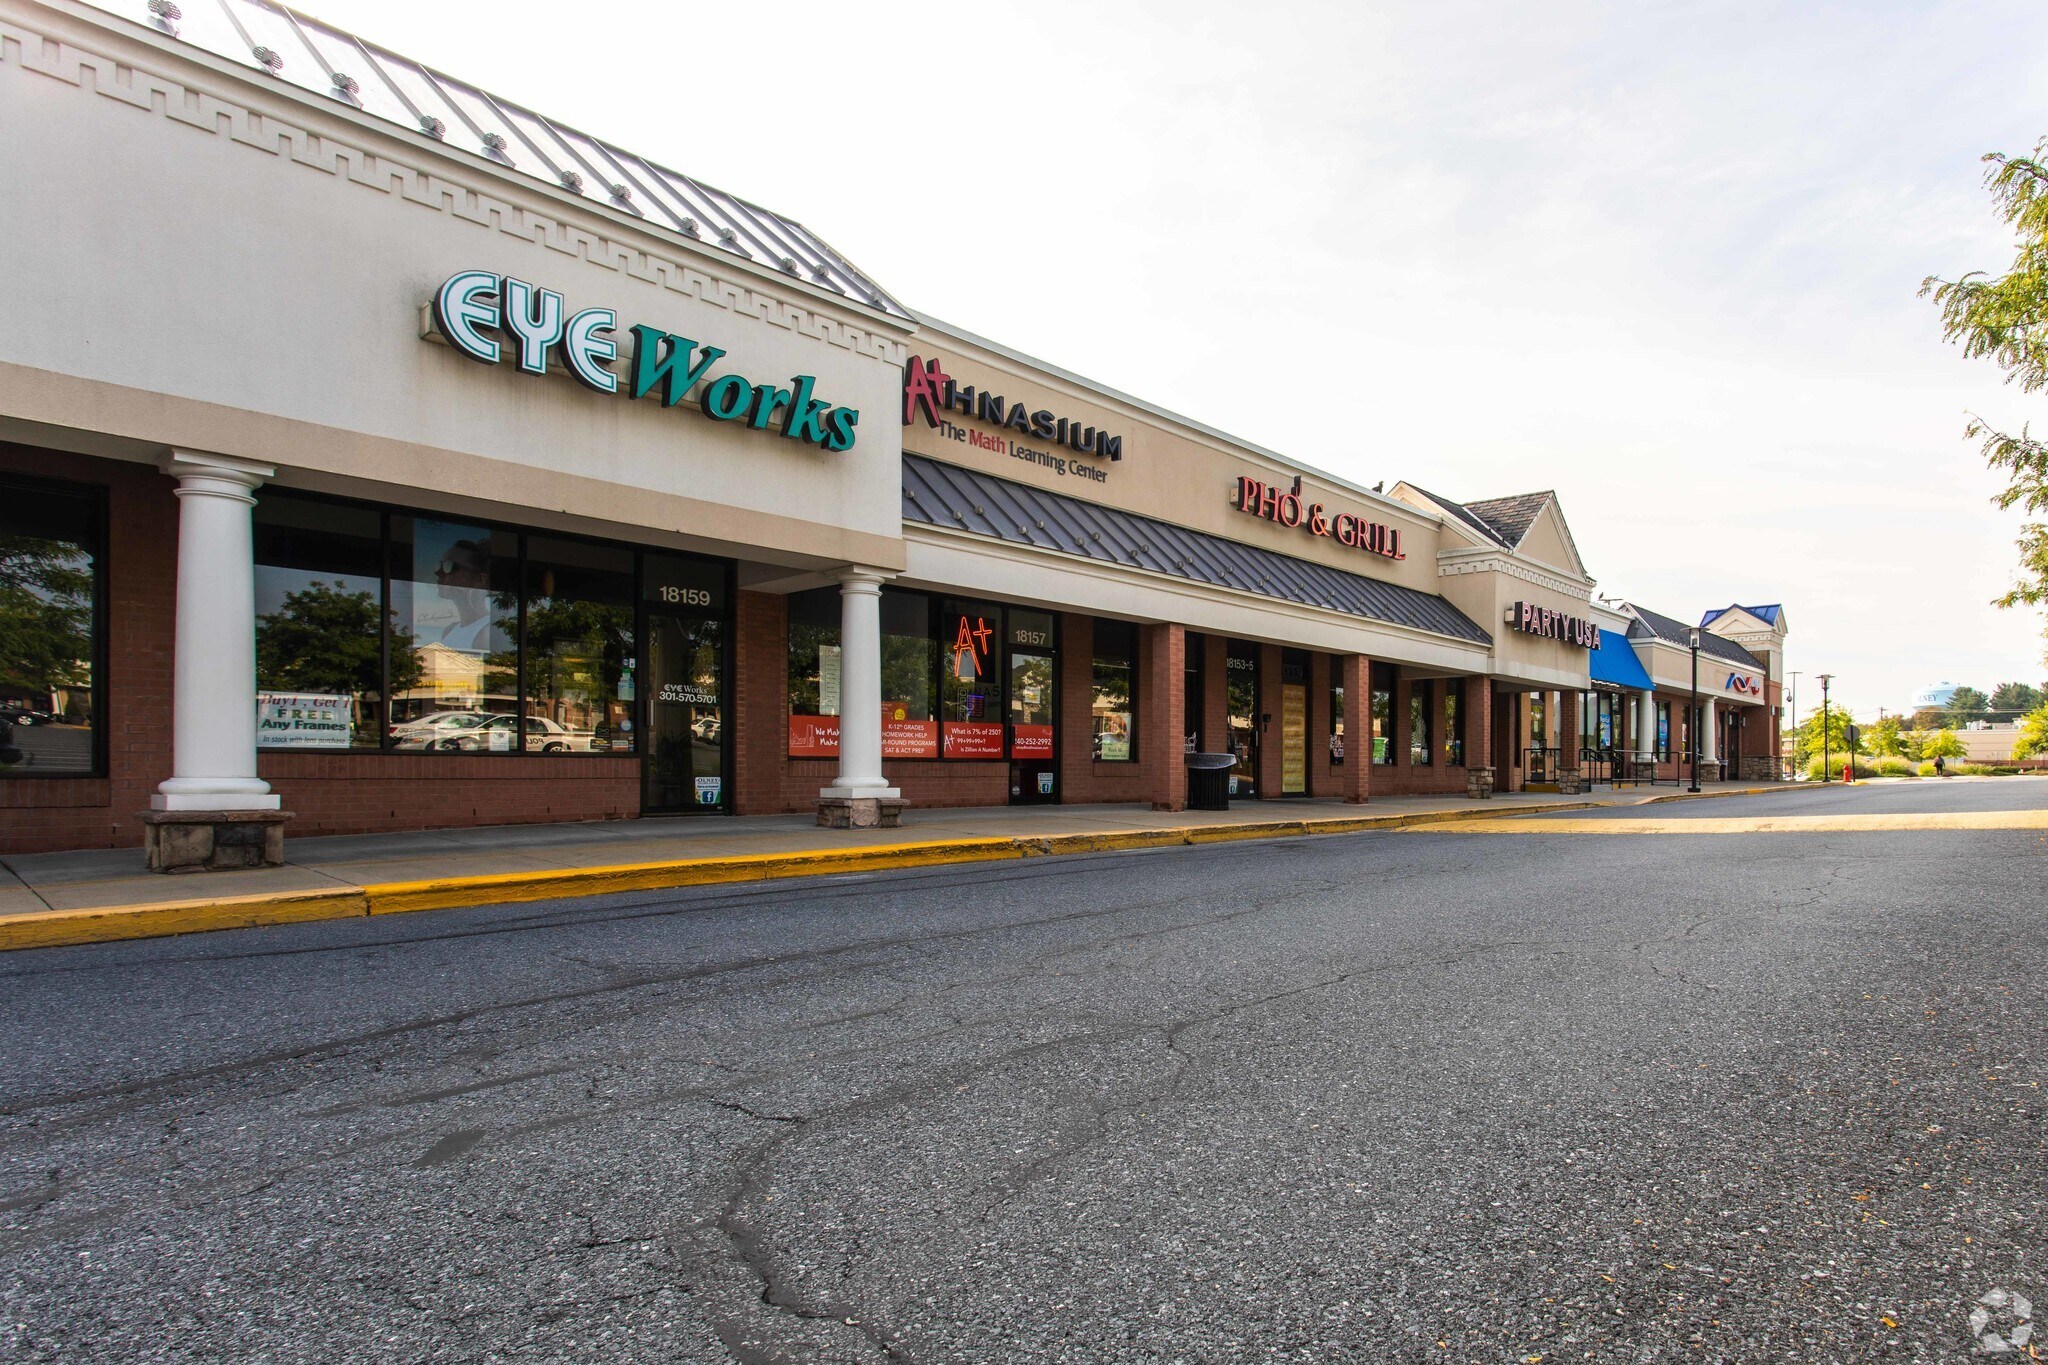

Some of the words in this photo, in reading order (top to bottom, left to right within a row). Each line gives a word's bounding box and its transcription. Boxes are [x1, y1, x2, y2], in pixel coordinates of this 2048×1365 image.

[434, 269, 617, 395] EYE
[628, 324, 859, 452] Works
[940, 421, 966, 442] The
[969, 428, 1006, 455] Math
[1009, 440, 1067, 475] Learning
[1068, 460, 1108, 483] Center
[1307, 503, 1330, 538] &
[1332, 513, 1406, 561] GRILL
[659, 586, 711, 606] 18159
[1515, 601, 1571, 642] PARTY
[1574, 617, 1601, 650] USA
[1015, 629, 1046, 645] 18157
[664, 683, 683, 692] EYE
[683, 684, 708, 694] Works
[260, 694, 289, 708] Buy
[313, 698, 339, 707] Get
[277, 709, 332, 720] FREE
[261, 718, 291, 730] Any
[294, 720, 346, 731] Frames
[815, 727, 826, 736] We
[988, 728, 1002, 736] 250?
[271, 736, 287, 744] stock
[819, 737, 838, 746] Make
